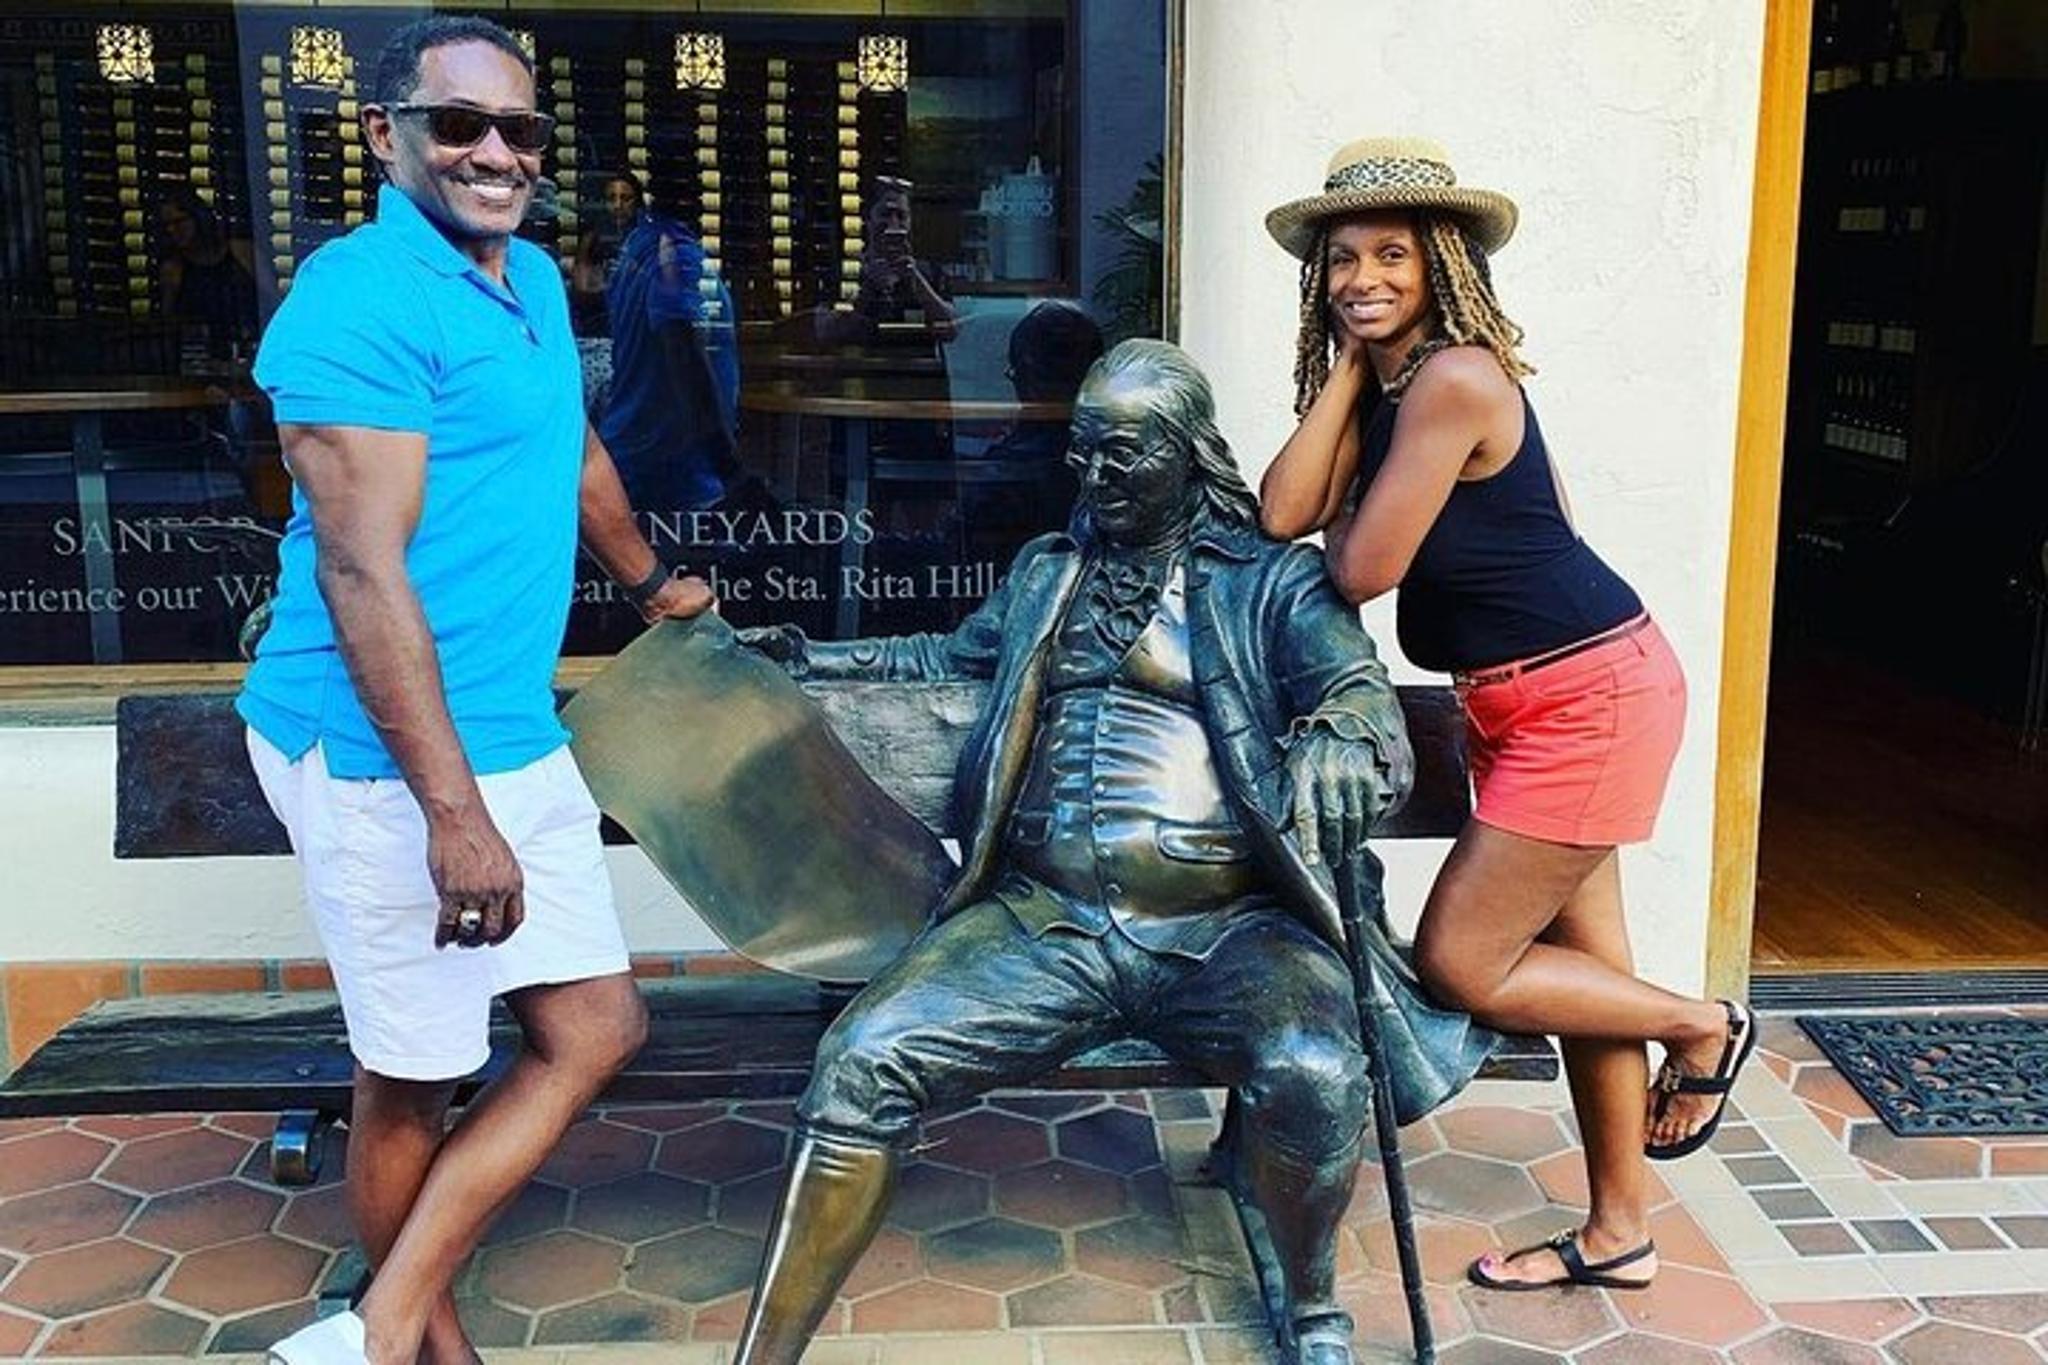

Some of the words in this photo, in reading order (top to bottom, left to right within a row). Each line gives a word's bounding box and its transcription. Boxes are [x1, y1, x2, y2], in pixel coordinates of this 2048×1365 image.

[633, 508, 875, 552] NEYARDS
[137, 586, 202, 611] our
[213, 573, 272, 608] Wi
[706, 565, 752, 604] he
[764, 565, 827, 601] Sta.
[842, 566, 917, 600] Rita
